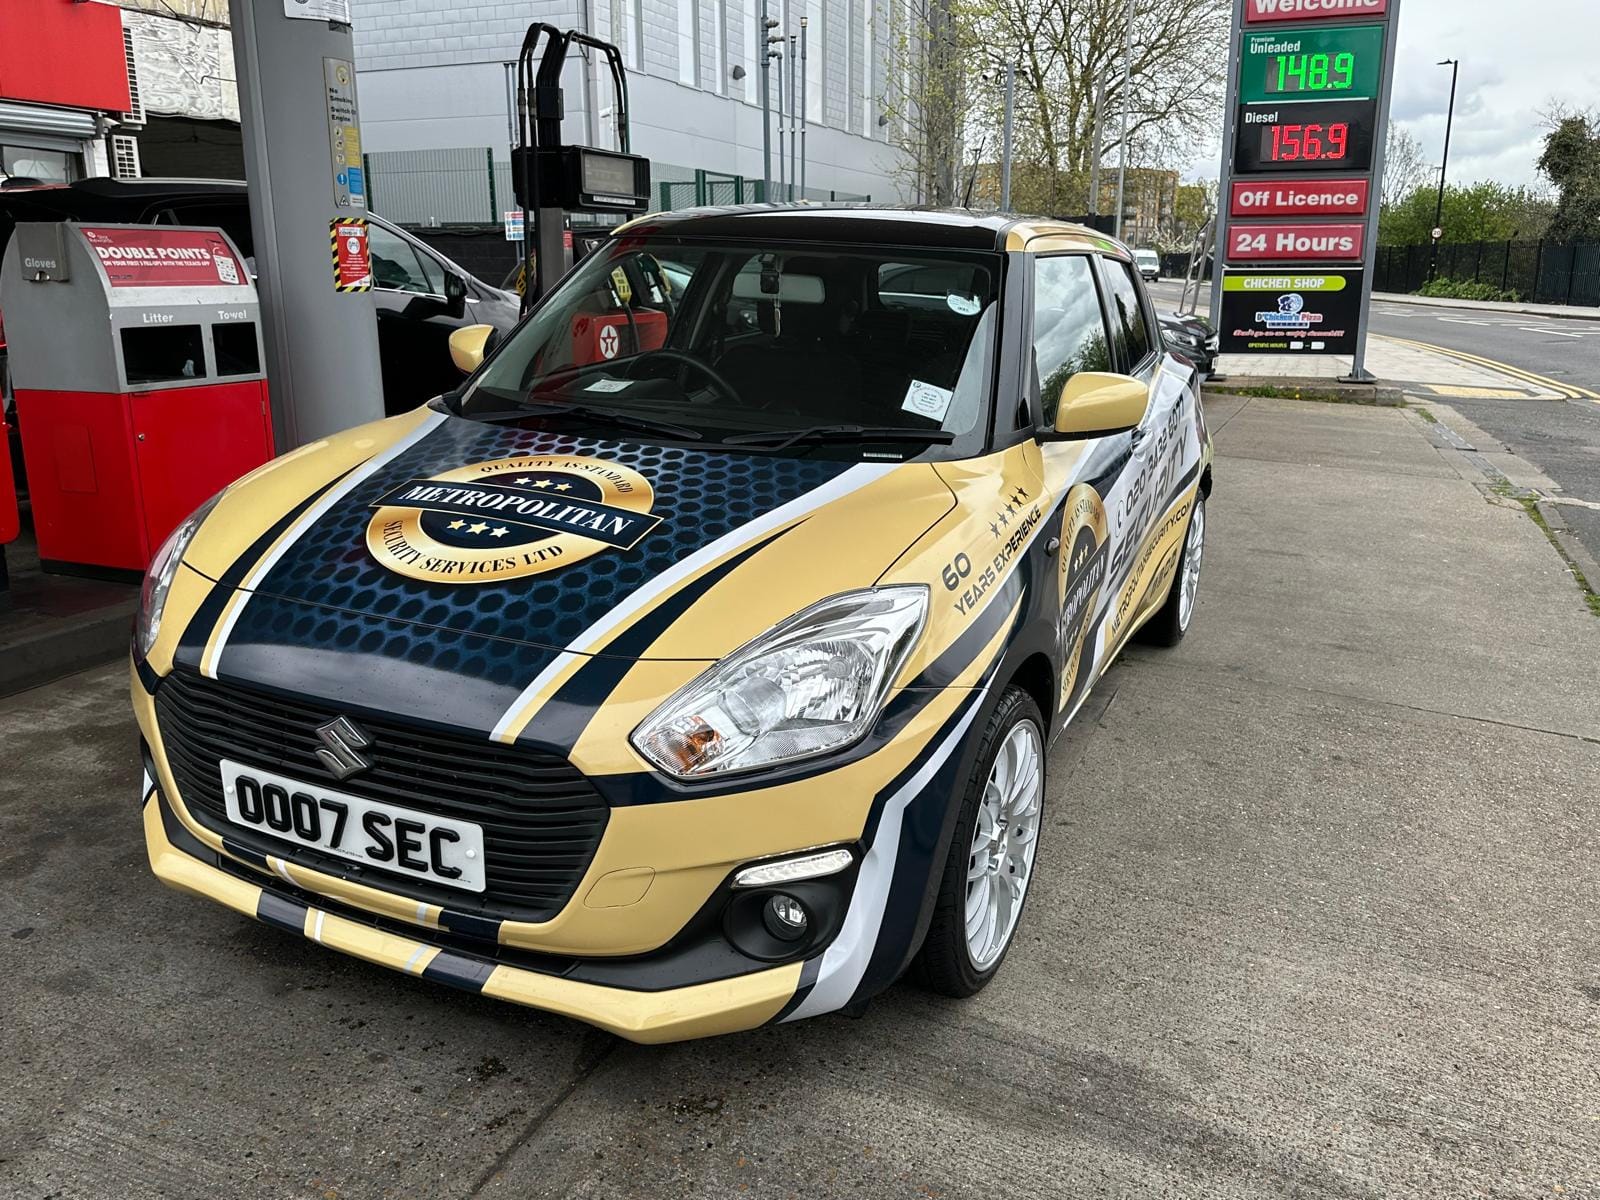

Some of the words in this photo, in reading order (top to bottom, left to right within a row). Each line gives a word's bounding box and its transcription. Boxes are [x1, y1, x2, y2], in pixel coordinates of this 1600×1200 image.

[1250, 41, 1301, 54] Unleaded
[1276, 52, 1354, 91] 148.9
[1245, 111, 1279, 124] Diesel
[1271, 123, 1348, 161] 156.9
[1239, 190, 1270, 207] Off
[1275, 190, 1359, 207] Licence
[1236, 233, 1267, 252] 24
[1275, 233, 1353, 252] Hours
[95, 246, 158, 260] DOUBLE
[160, 247, 211, 260] POINTS
[24, 257, 57, 269] Gloves
[1293, 278, 1325, 289] SHOP
[142, 312, 174, 324] Litter
[217, 309, 248, 321] Towel
[480, 460, 556, 473] QUALITY
[1126, 468, 1146, 516] 020
[397, 485, 635, 536] METROPOLITAN
[1105, 425, 1188, 593] SECURITY
[383, 520, 424, 565] SECURITY
[419, 556, 517, 575] SERVICES
[523, 544, 564, 565] LTD
[954, 565, 996, 617] YEARS
[992, 503, 1042, 574] EXPERIENCE
[942, 552, 972, 592] 60
[362, 810, 463, 880] SEC
